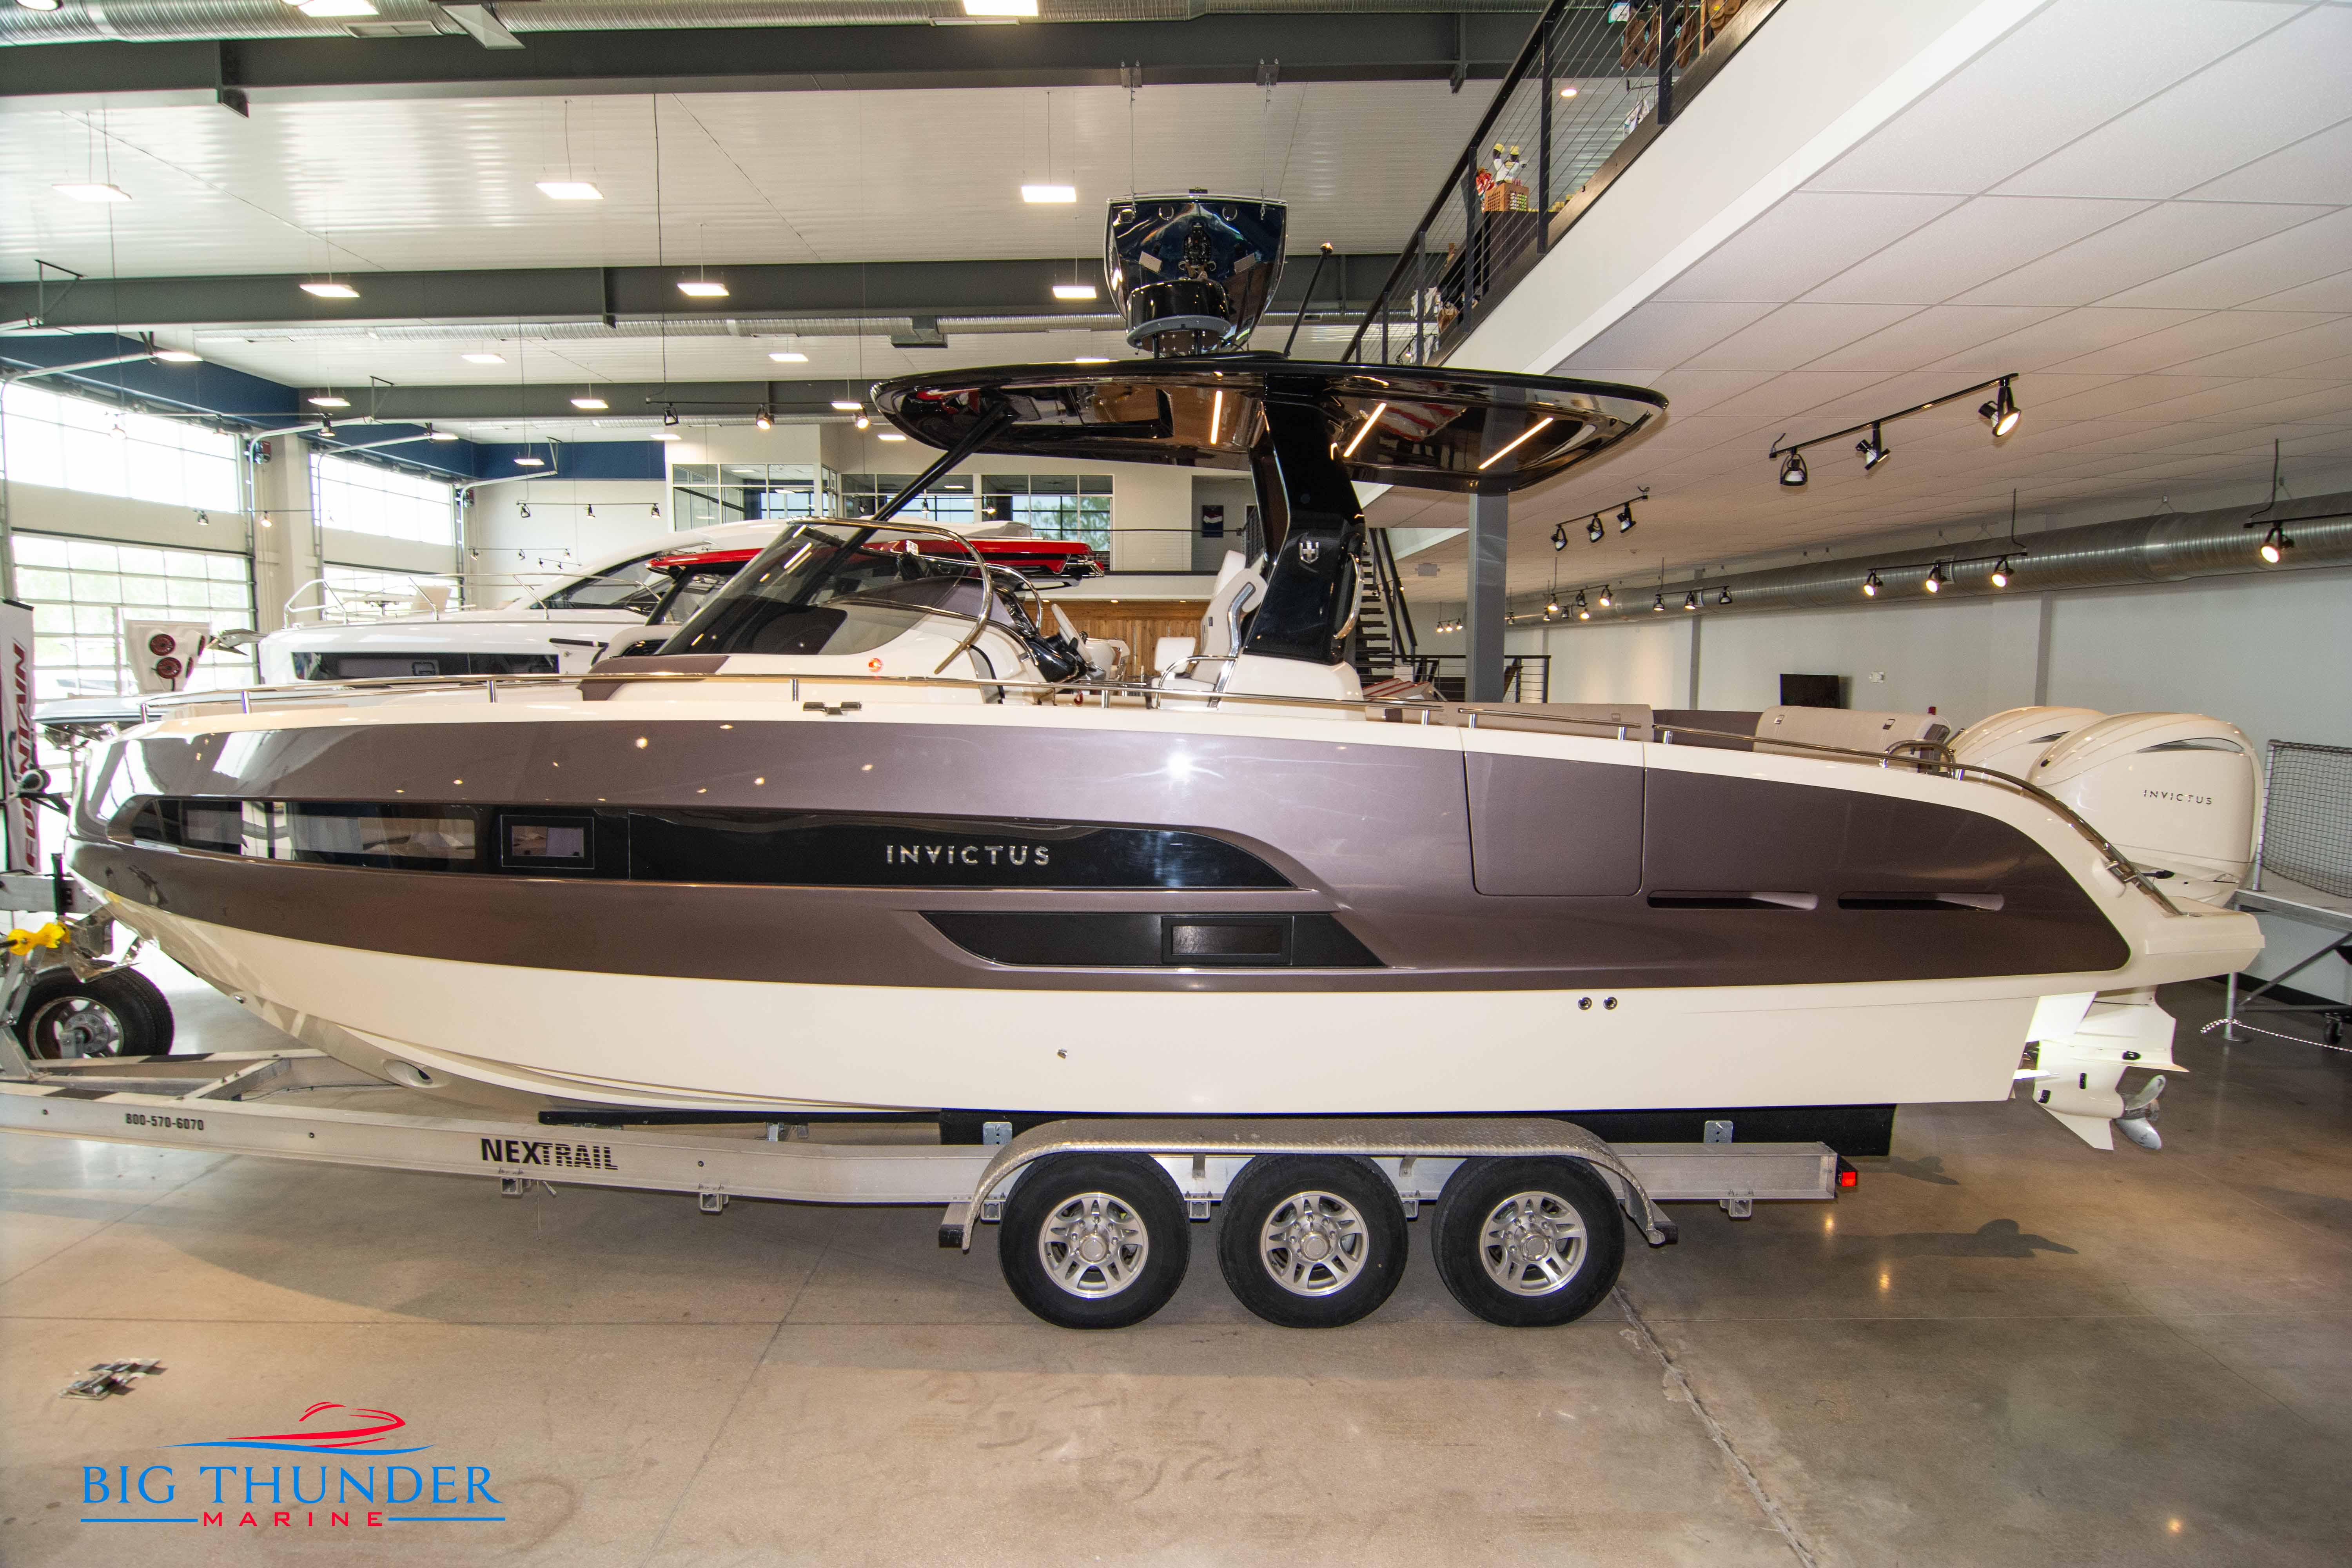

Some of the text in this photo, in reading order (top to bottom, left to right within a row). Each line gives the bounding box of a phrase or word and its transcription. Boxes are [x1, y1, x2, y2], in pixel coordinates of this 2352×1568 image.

[13, 641, 36, 867] FONTAIN
[2143, 789, 2213, 805] INVICTUS
[887, 845, 1049, 866] INVICTUS
[125, 1113, 204, 1131] 800-570-6070
[481, 1138, 618, 1171] NEXTRAIL
